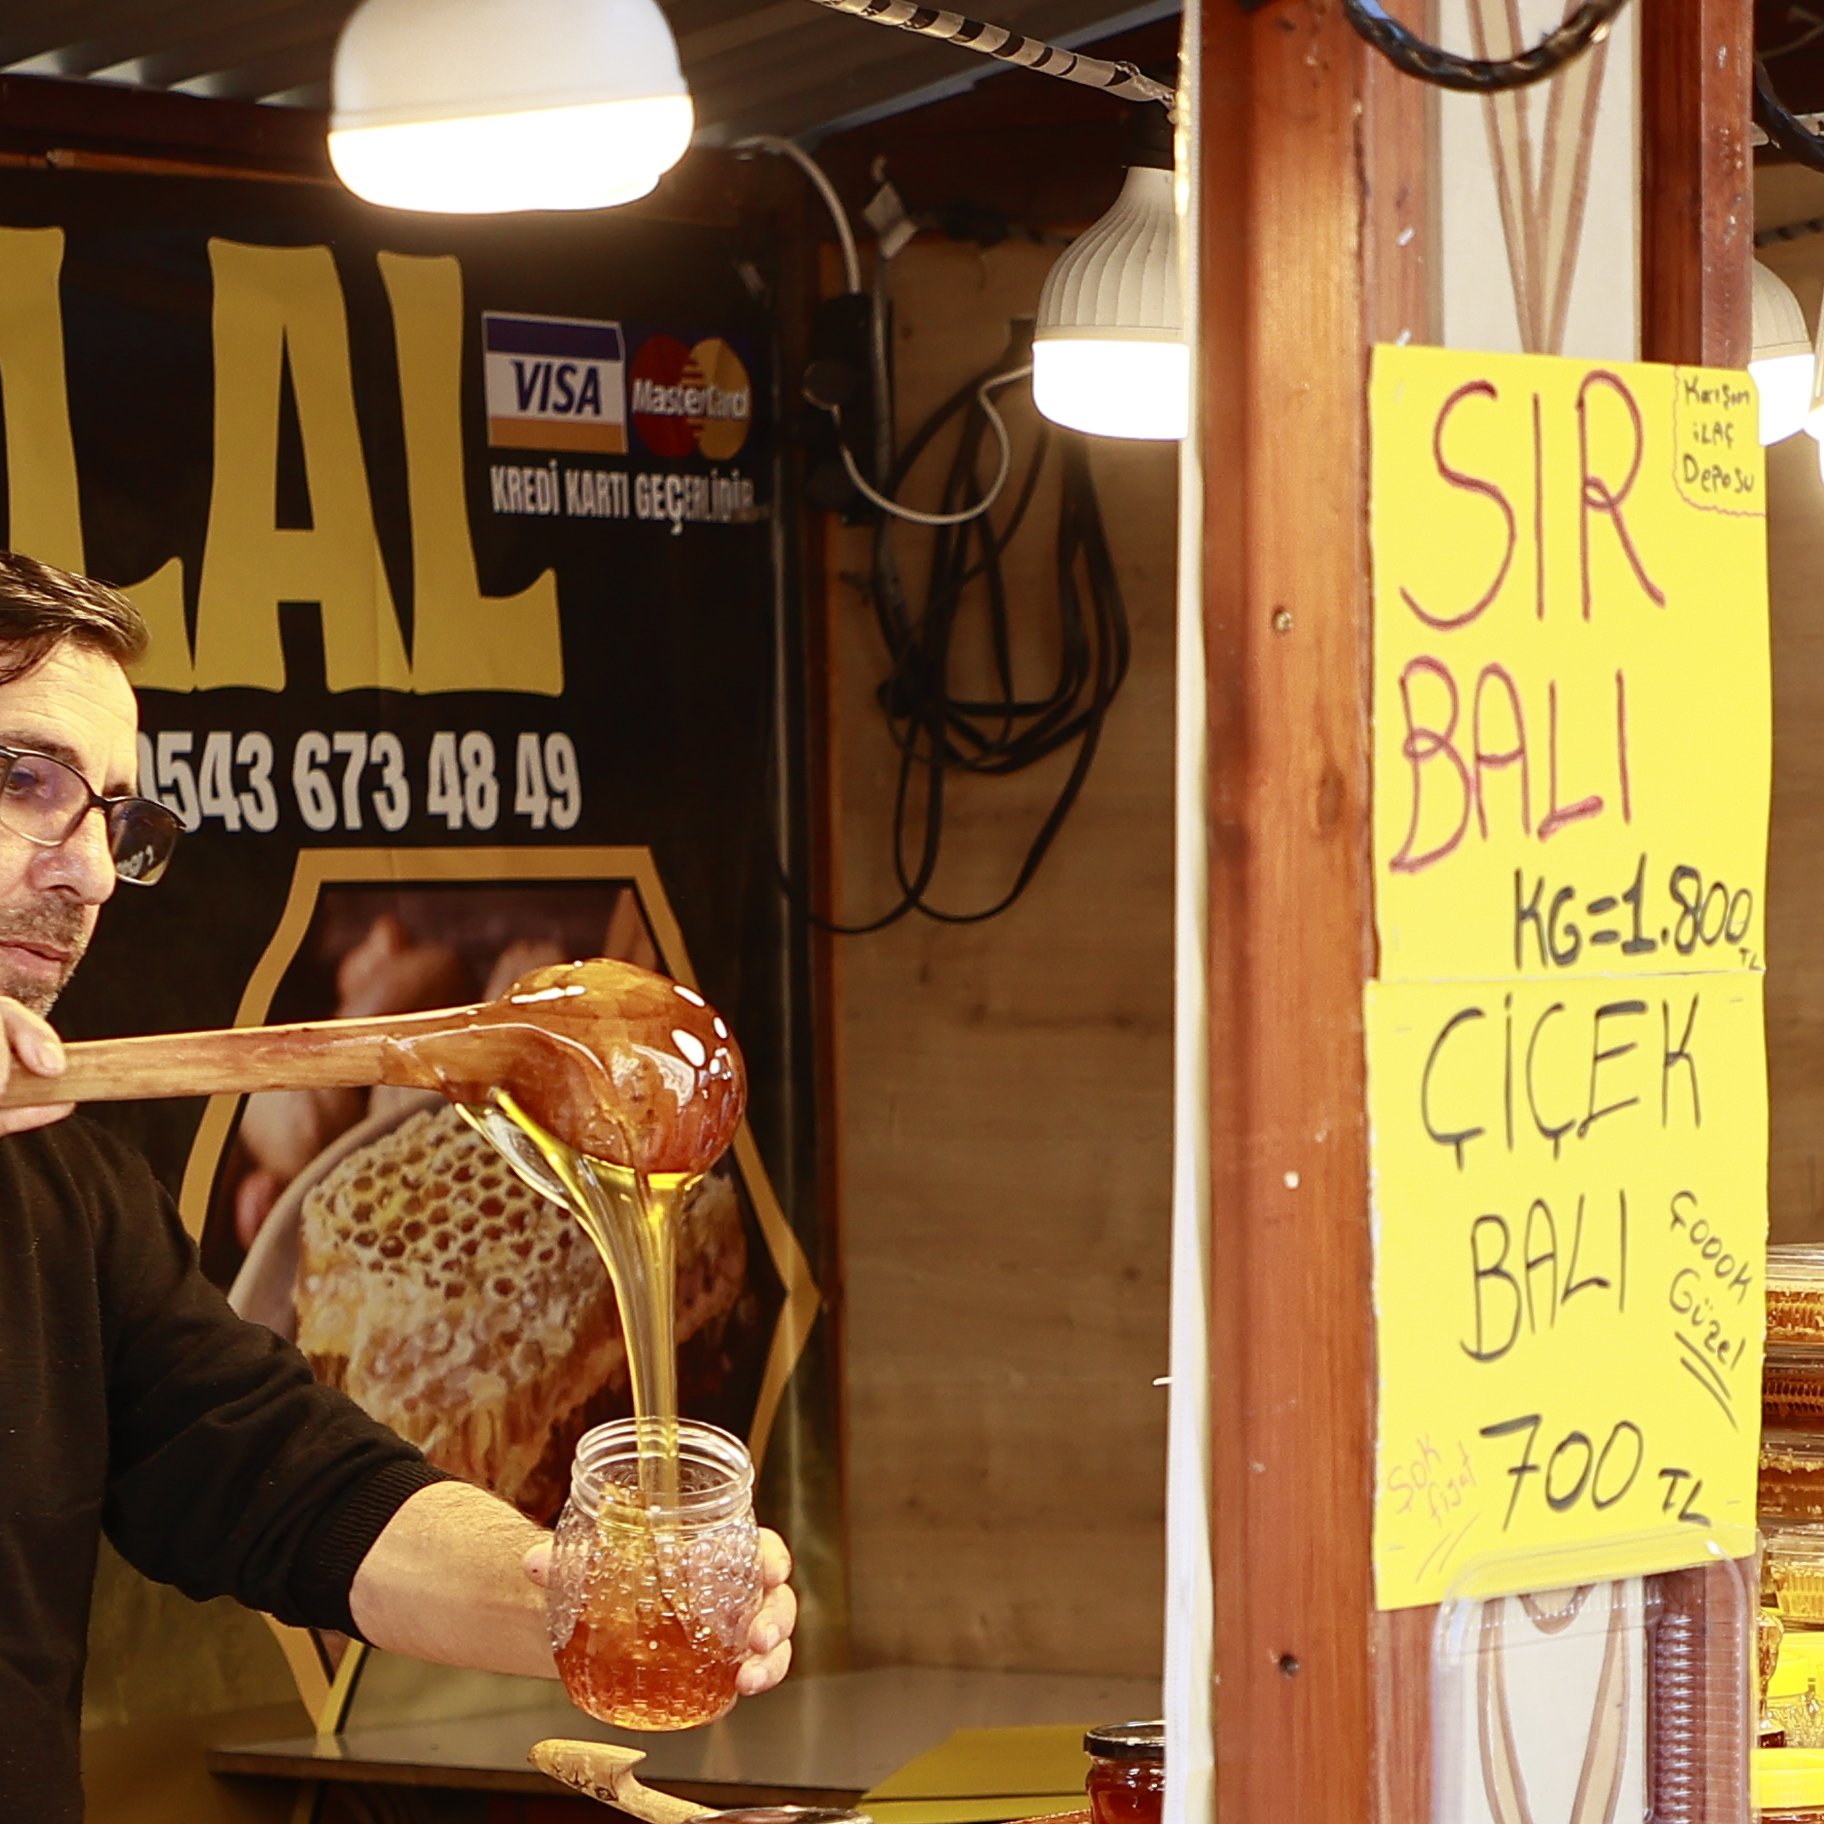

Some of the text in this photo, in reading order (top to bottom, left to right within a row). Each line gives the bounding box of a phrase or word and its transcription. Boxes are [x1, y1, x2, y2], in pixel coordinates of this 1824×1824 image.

[514, 361, 601, 416] VISA
[631, 377, 752, 420] MasterCard
[490, 457, 561, 515] KREDİ
[565, 470, 629, 520] KARTI
[1400, 368, 1667, 632] SIR
[293, 730, 412, 832] 673
[427, 730, 499, 831] 48
[513, 731, 582, 831] 49
[1388, 655, 1633, 874] BALI
[1420, 992, 1702, 1172] ÇİÇEK
[1459, 1188, 1628, 1364] BALI
[1479, 1412, 1711, 1533] 700 TL
